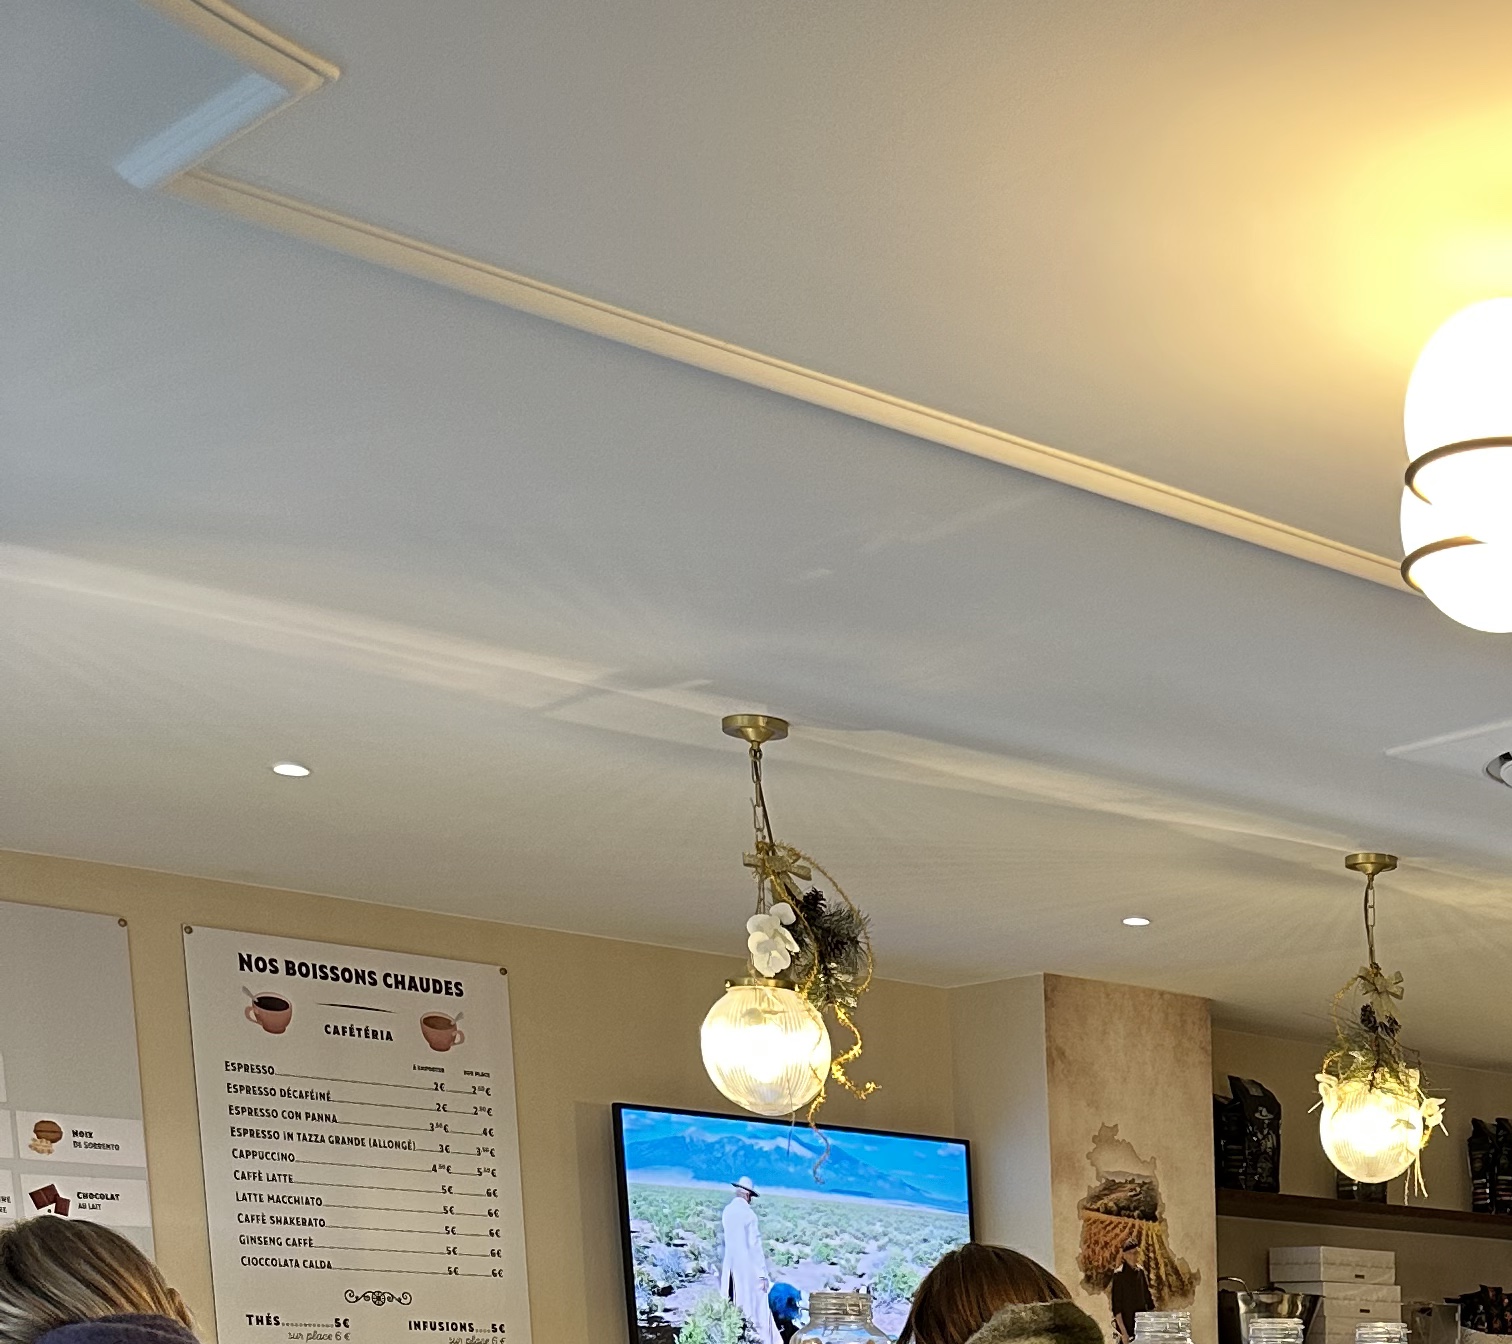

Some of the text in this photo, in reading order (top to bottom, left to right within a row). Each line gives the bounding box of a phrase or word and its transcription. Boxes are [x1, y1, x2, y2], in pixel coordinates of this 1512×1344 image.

[238, 952, 464, 997] NOS BOISSONS CHAUDES
[324, 1023, 394, 1042] CAFÉTÉRIA
[224, 1060, 275, 1076] ESPRESSO
[433, 1081, 446, 1092] 2€
[226, 1082, 276, 1098] ESPRESSO
[279, 1086, 331, 1102] DÉCAFÉINÉ
[435, 1102, 448, 1113] 2€
[228, 1104, 278, 1120] ESPRESSO
[281, 1108, 302, 1122] CON
[305, 1110, 338, 1124] PANNA
[482, 1127, 495, 1138] 4€
[72, 1129, 93, 1139] NOIX
[230, 1126, 280, 1141] ESPRESSO
[283, 1130, 294, 1142] IN
[296, 1131, 326, 1144] TAZZA
[328, 1133, 366, 1148] GRANDE
[438, 1143, 451, 1154] 3€
[231, 1148, 296, 1163] CAPPUCCINO
[76, 1191, 120, 1201] CHOCOLAT
[233, 1169, 499, 1198] CAFFÈ LATTE 5€ 6€
[235, 1191, 500, 1219] LATTE MACCHIATO 5€ 6€
[237, 1212, 501, 1239] CAFFÈ SHAKERATO 5€ 6€
[239, 1234, 503, 1259] GINSENG CAFFÈ 5€ 6€
[240, 1255, 504, 1279] CIOCCOLATA CALDA 5€ 6€
[334, 1317, 351, 1330] 5€
[408, 1319, 507, 1335] INFUSIONS 5€
[288, 1331, 304, 1341] sur
[305, 1331, 333, 1343] place
